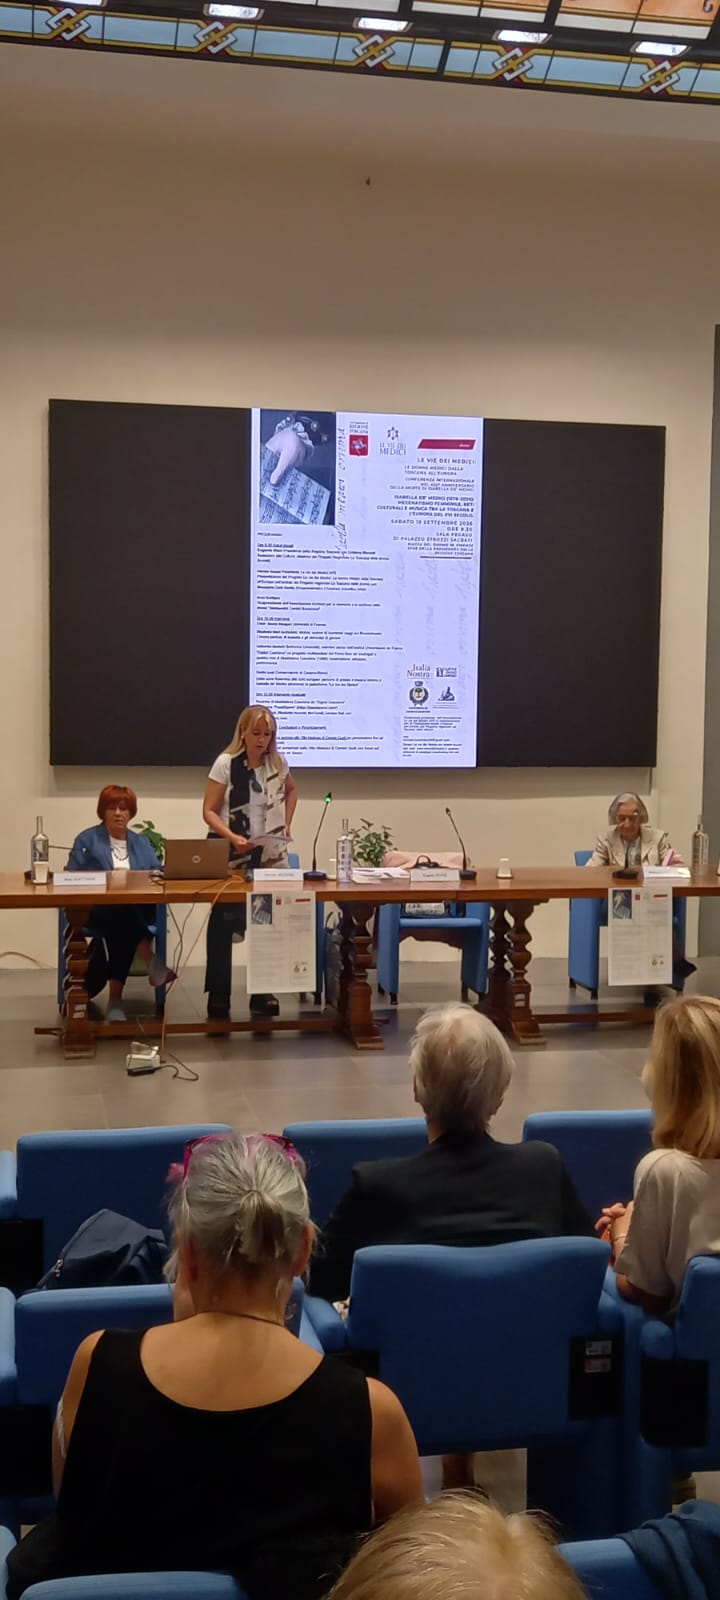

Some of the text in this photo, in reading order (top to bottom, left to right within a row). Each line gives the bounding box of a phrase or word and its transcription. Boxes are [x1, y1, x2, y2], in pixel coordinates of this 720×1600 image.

[379, 448, 407, 456] MEDICI
[412, 663, 430, 672] Italia
[407, 670, 430, 678] Nostra
